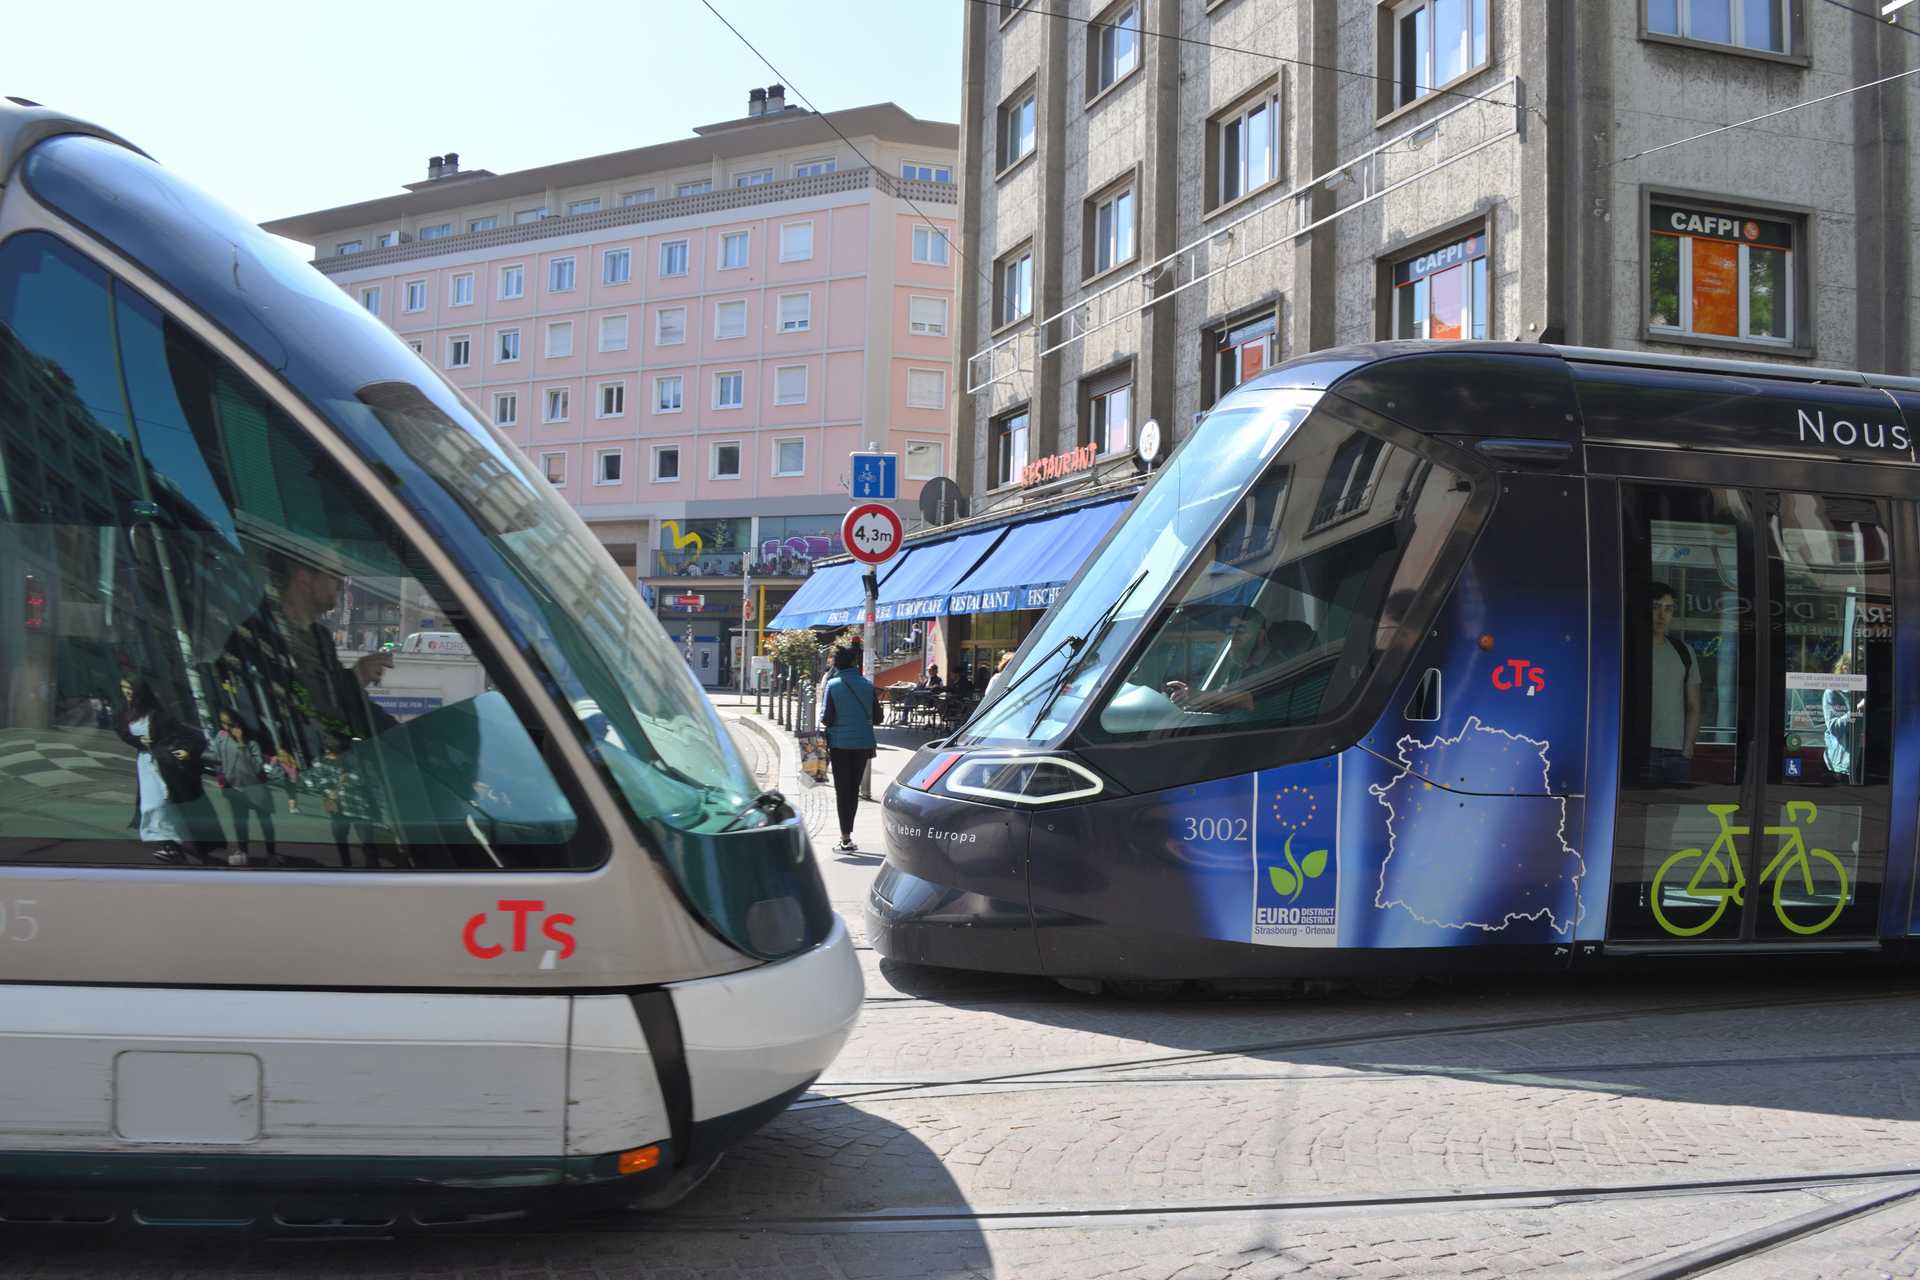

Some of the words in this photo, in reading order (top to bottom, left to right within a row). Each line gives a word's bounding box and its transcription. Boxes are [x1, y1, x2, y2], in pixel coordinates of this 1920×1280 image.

[1671, 212, 1740, 237] CAFPI
[1415, 243, 1463, 273] CAFPI
[1798, 409, 1908, 450] Nous
[1020, 441, 1098, 487] RESTAURANT
[854, 525, 892, 543] 4,3m
[949, 592, 1010, 612] RESTAURANT
[927, 827, 977, 844] Europa
[1183, 817, 1249, 842] 3002
[1256, 907, 1300, 924] EURO
[1255, 925, 1298, 937] Strasbourg
[1305, 925, 1336, 935] Ortenau
